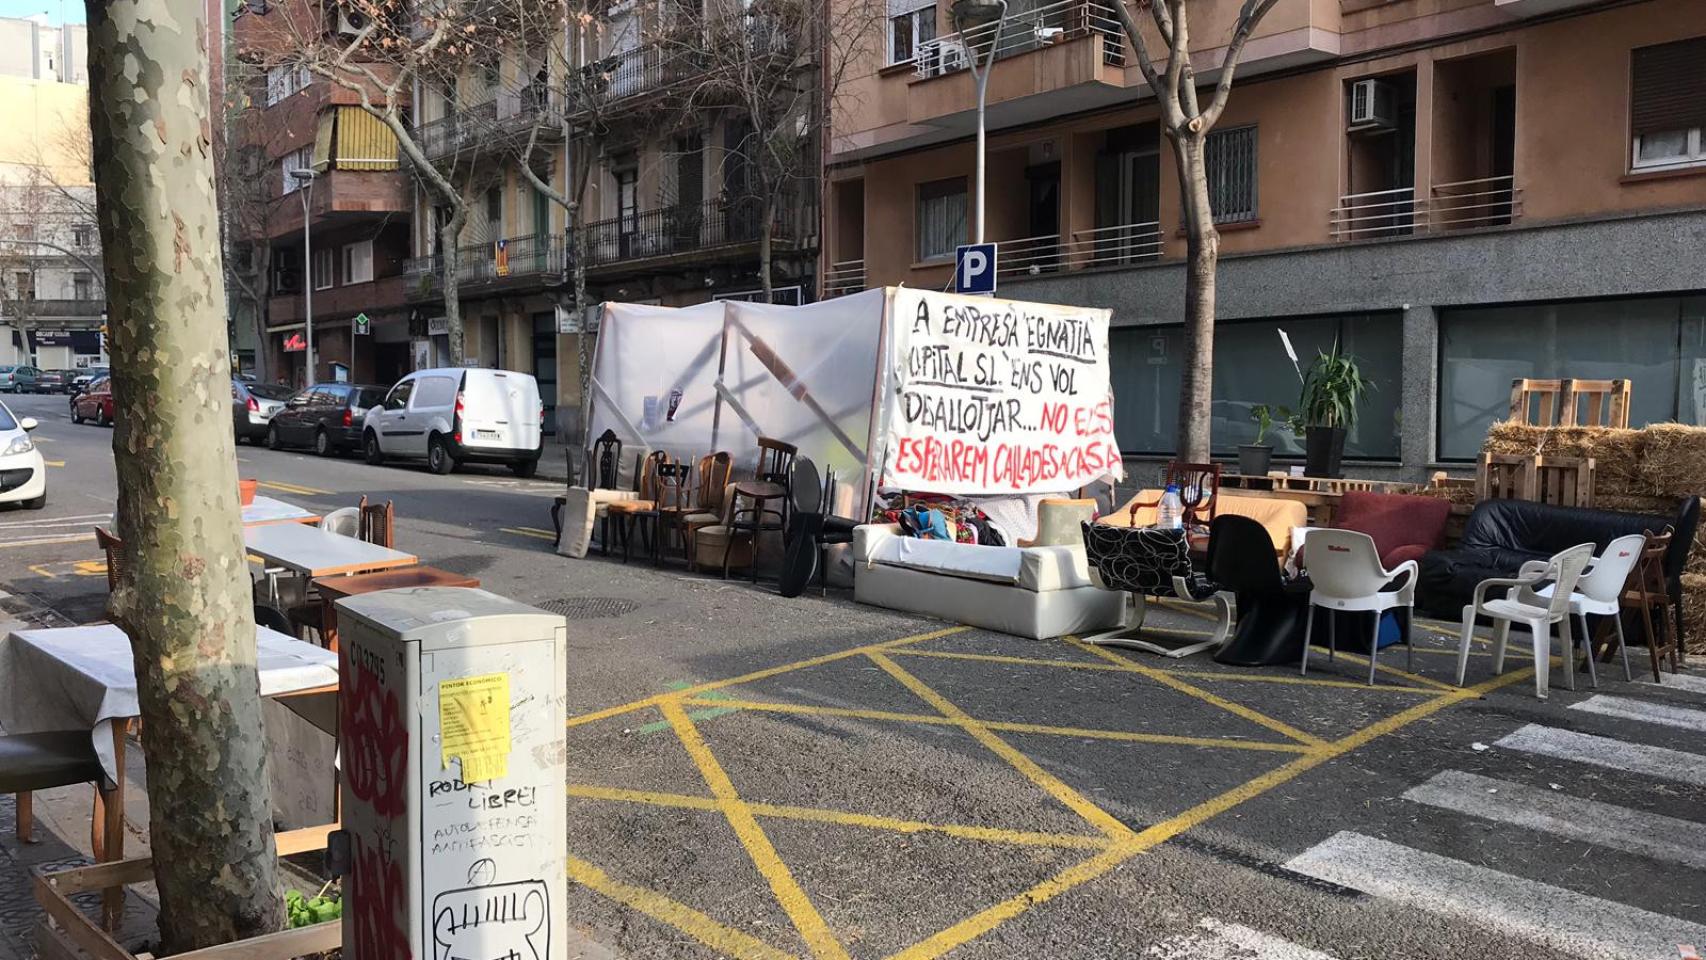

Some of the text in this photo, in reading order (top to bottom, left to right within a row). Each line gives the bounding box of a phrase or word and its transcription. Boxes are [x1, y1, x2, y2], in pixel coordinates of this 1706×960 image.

[963, 250, 988, 289] P
[1049, 363, 1078, 395] VOL
[1040, 402, 1068, 434] NO
[1075, 402, 1112, 437] ELS
[895, 435, 988, 489] ESPERAREM
